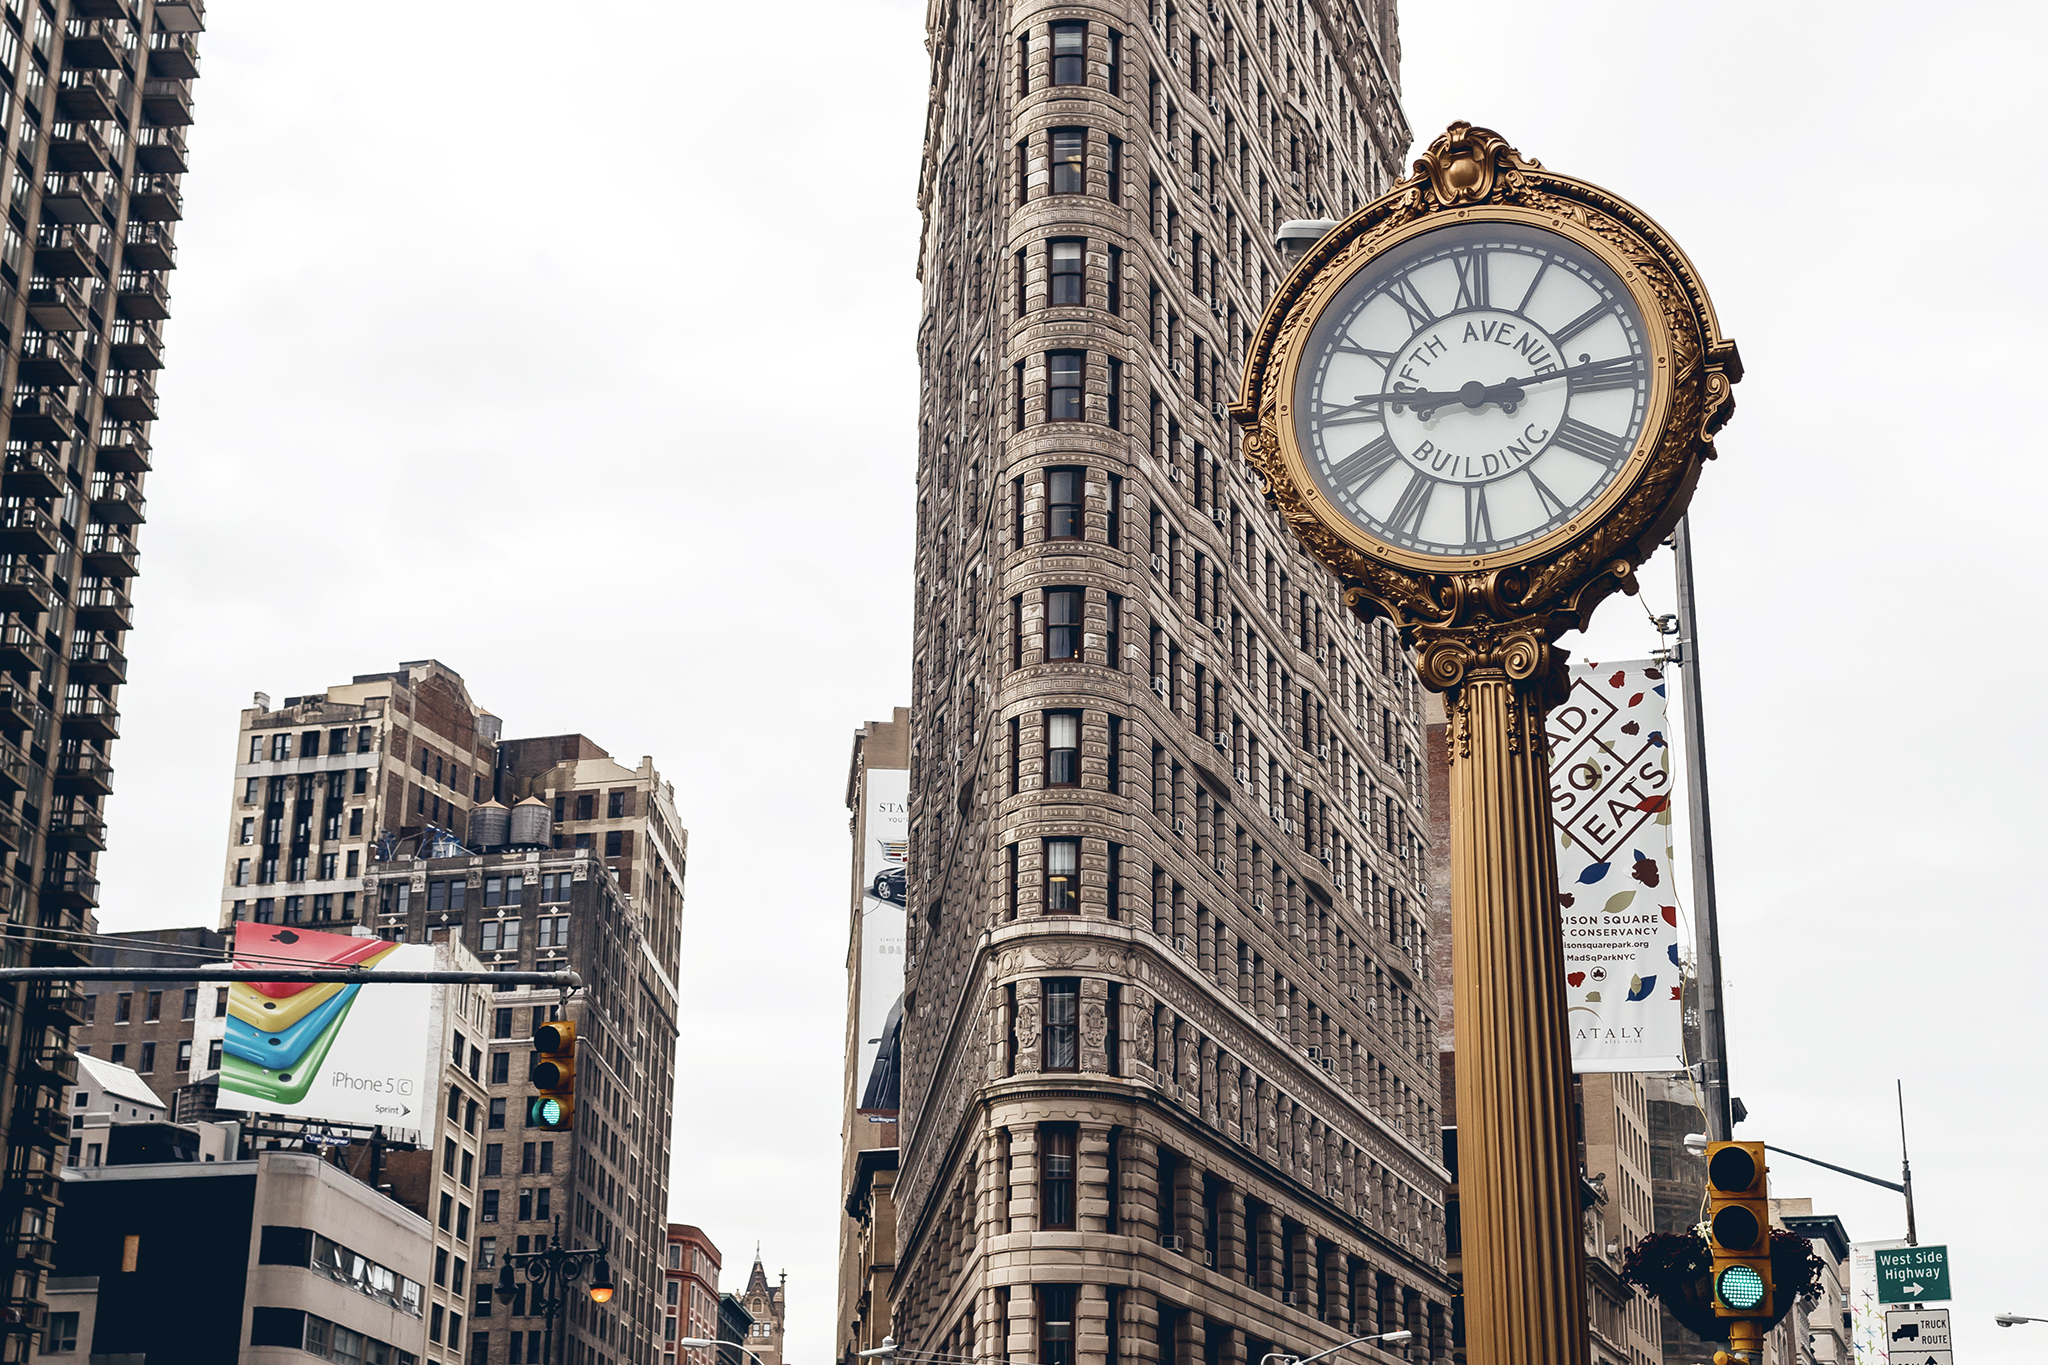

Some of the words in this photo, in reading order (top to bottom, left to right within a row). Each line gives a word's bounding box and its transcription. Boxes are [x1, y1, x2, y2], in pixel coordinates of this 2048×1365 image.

[1398, 333, 1448, 392] IFTH
[1411, 423, 1549, 479] BUILDING
[1550, 763, 1611, 811] SQ.
[879, 802, 908, 813] STA
[1582, 762, 1668, 846] EATS
[1603, 914, 1659, 925] SQUARE
[1570, 927, 1658, 937] CONSERVANCY
[1564, 941, 1649, 950] isonsquarepark.org
[1565, 953, 1636, 962] MadSqParkNYC
[1576, 1027, 1644, 1039] ATALY
[332, 1072, 382, 1093] iPhone
[375, 1104, 399, 1115] Sprint
[1880, 1253, 1911, 1267] West
[1915, 1251, 1943, 1264] Side
[1885, 1267, 1940, 1282] Highway
[1920, 1319, 1947, 1329] TRUCK
[1921, 1335, 1948, 1345] ROUTE
